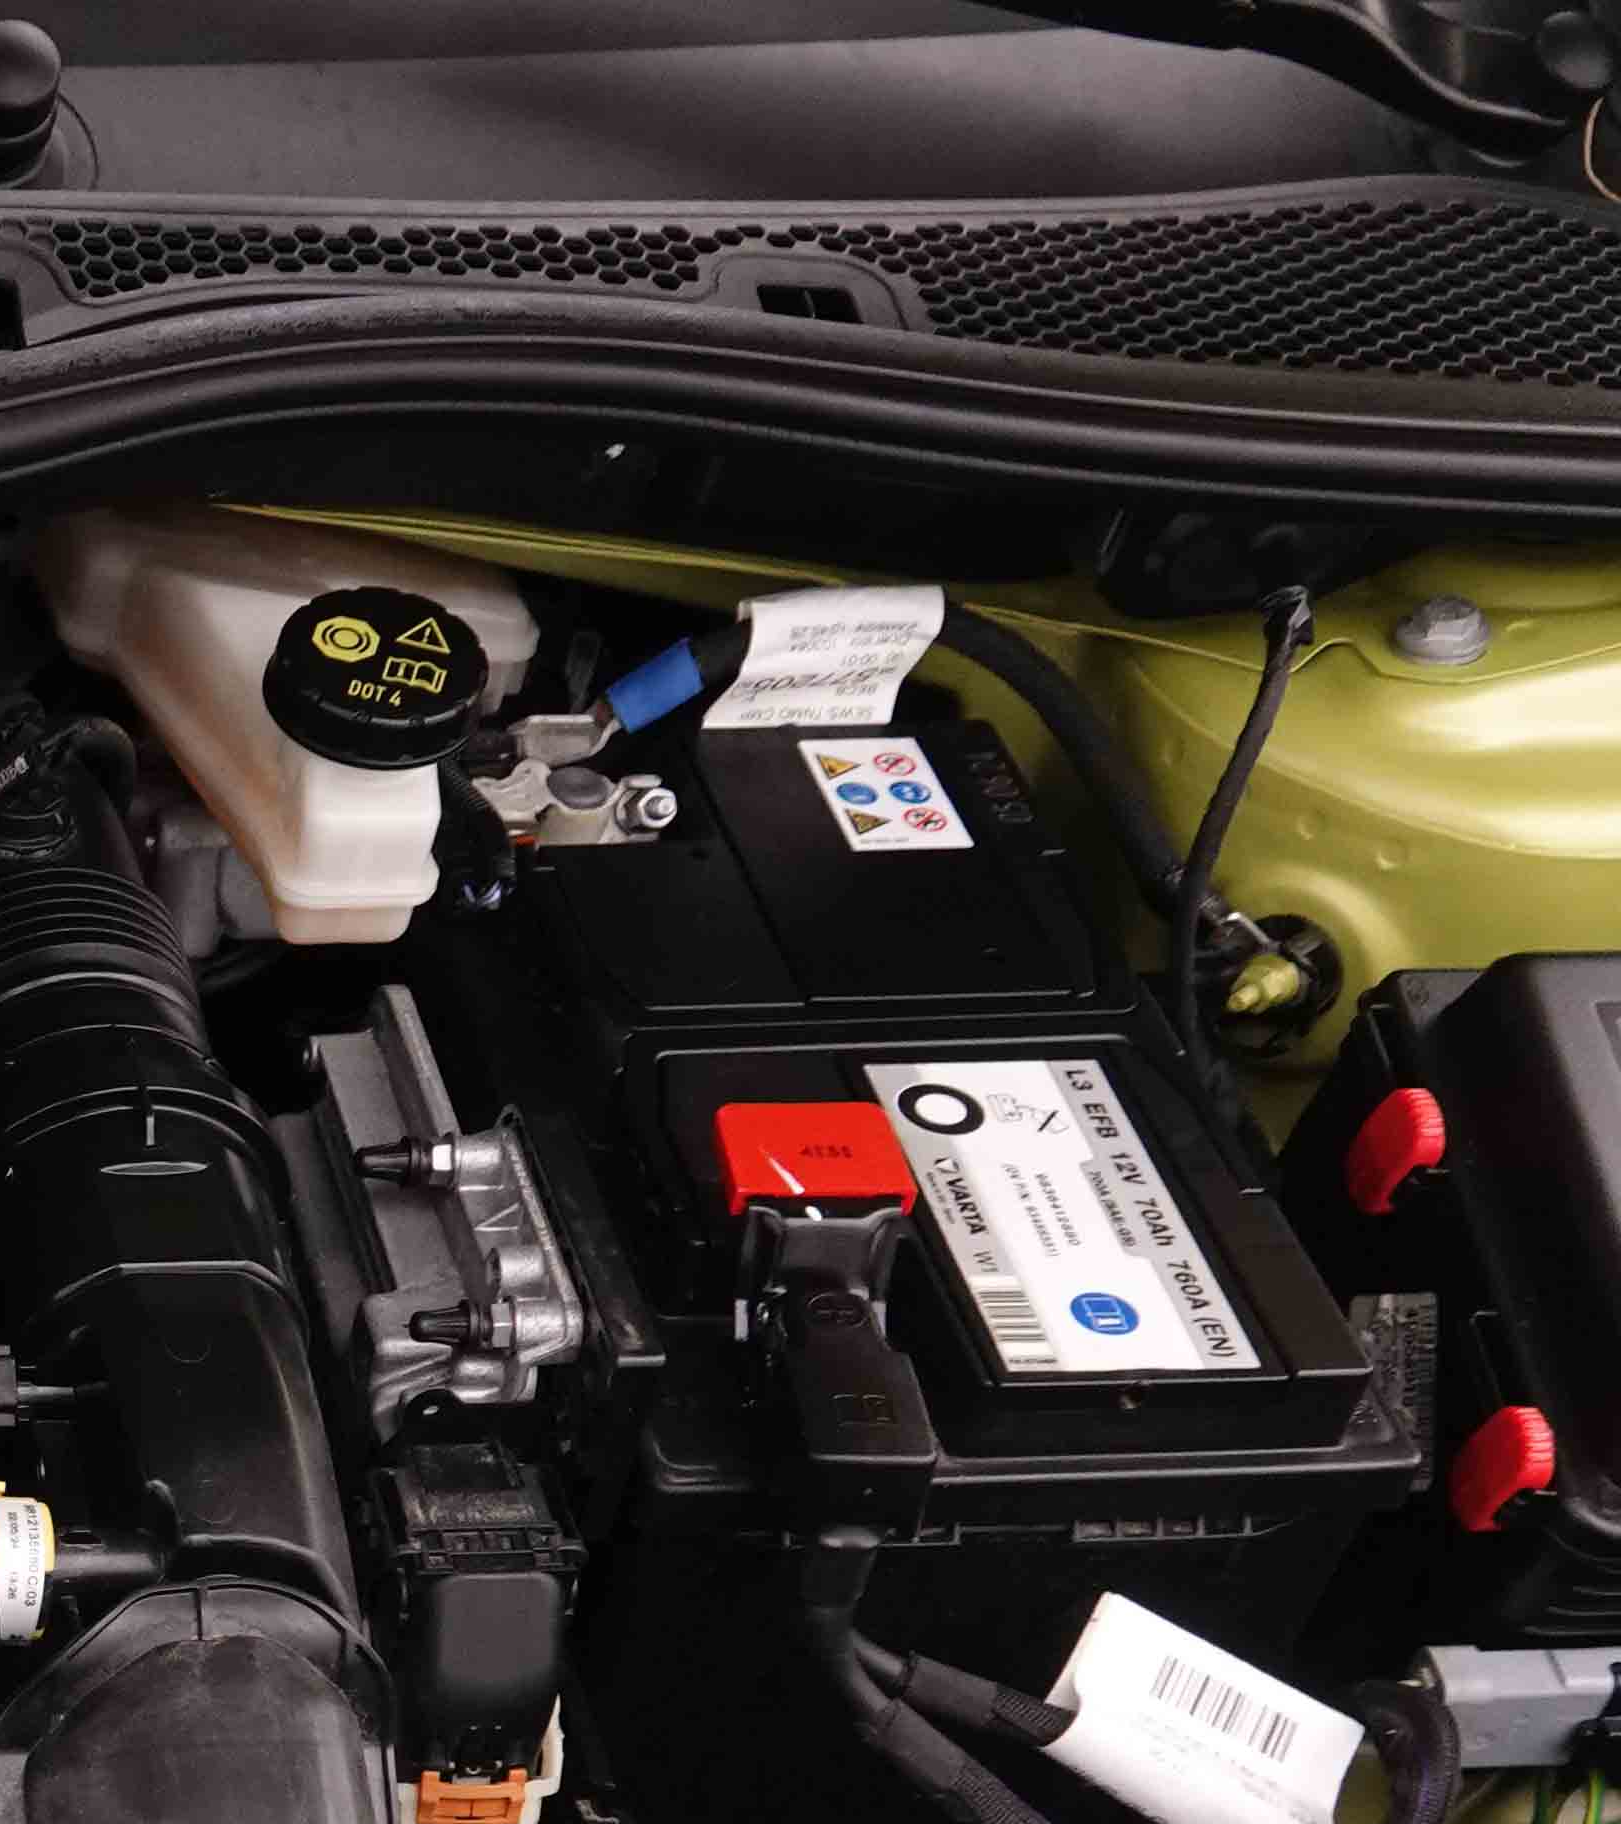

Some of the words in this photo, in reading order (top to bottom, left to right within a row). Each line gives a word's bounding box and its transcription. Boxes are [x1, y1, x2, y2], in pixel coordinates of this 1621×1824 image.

[347, 679, 388, 703] DOT
[388, 689, 403, 707] 4
[945, 1177, 988, 1235] VARTA
[1084, 1103, 1118, 1138] EFB
[1110, 1152, 1145, 1185] 12V
[1135, 1199, 1176, 1246] 70Ah
[1167, 1260, 1210, 1310] 760A
[1194, 1318, 1238, 1357] (EN)
